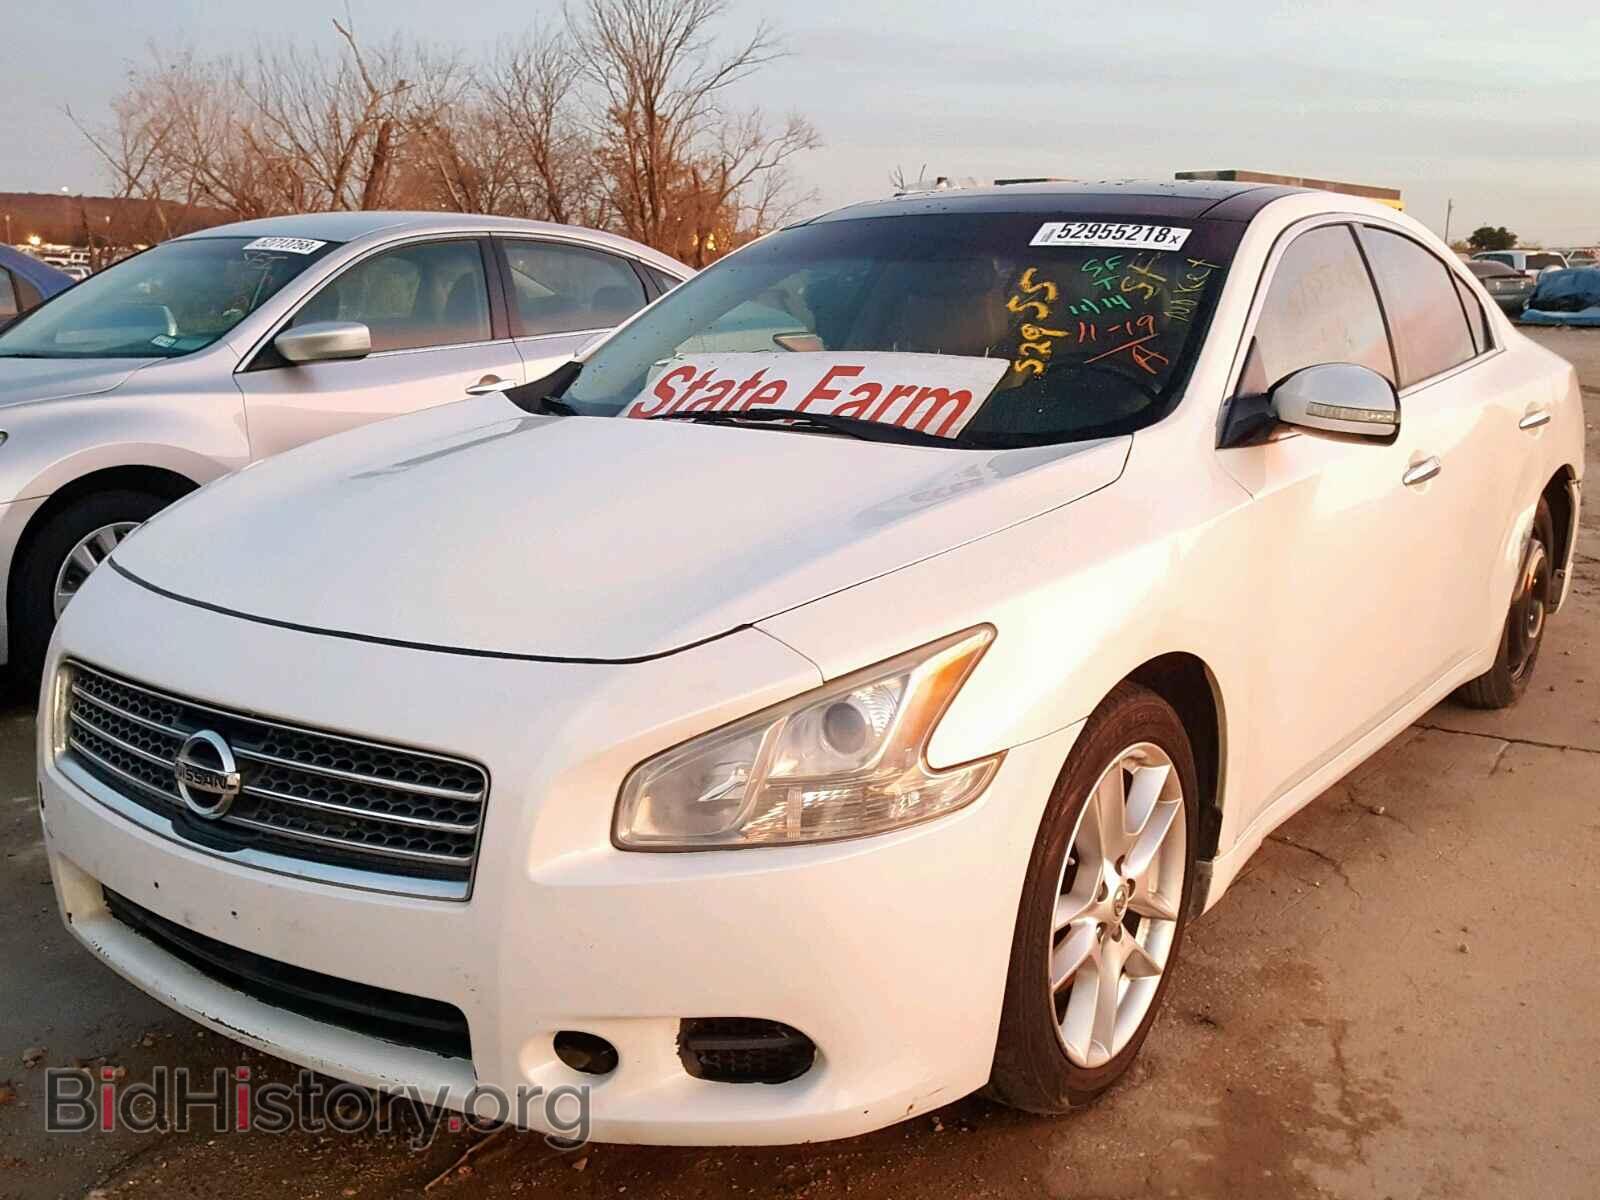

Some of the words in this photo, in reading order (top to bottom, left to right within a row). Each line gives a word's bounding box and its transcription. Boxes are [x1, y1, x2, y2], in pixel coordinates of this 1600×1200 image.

[627, 365, 788, 421] State
[783, 365, 973, 438] Farm
[176, 762, 228, 790] NISSAN
